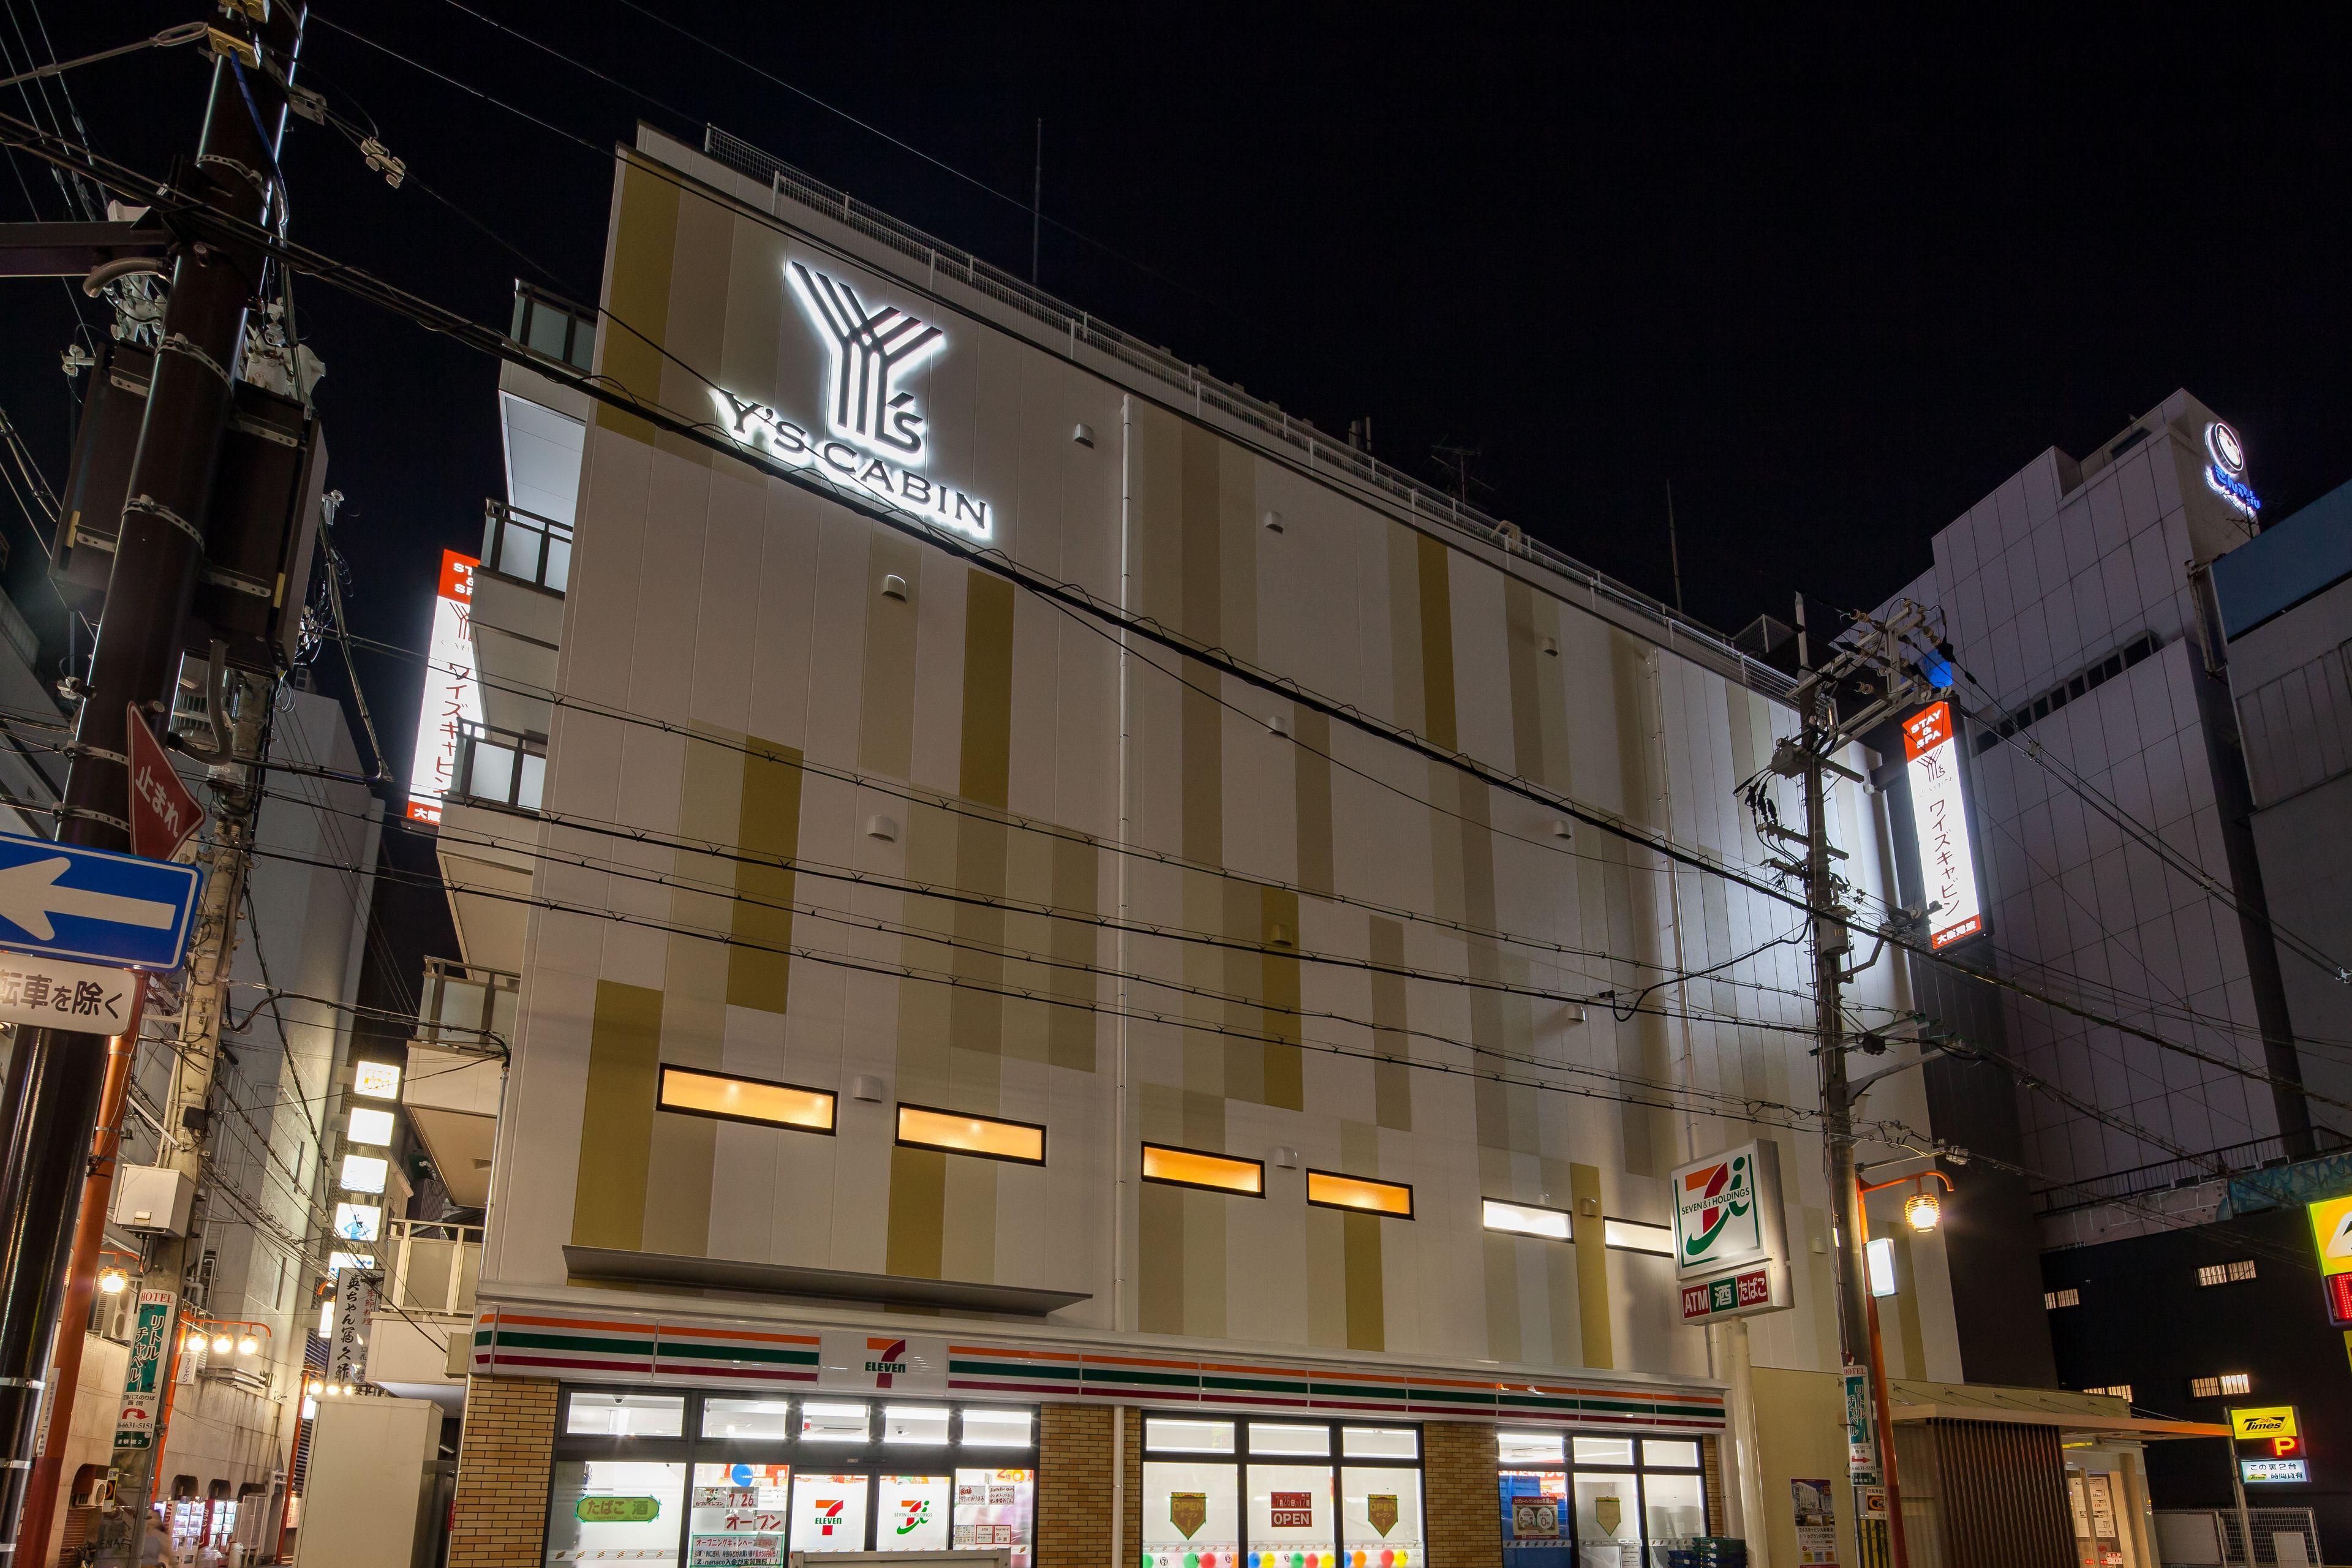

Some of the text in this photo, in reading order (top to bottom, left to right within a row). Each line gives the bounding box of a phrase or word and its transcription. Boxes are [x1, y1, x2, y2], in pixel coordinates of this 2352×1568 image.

[824, 442, 986, 530] CABIN
[1910, 709, 1942, 734] STAY
[1923, 726, 1931, 736] &
[1917, 729, 1942, 749] SPA
[135, 765, 178, 839] 止まれ
[1929, 799, 1959, 917] ワイズキャビン
[1712, 1186, 1750, 1205] HOLDINGS
[140, 1292, 173, 1304] HOTEL
[1684, 1276, 1768, 1314] ATM 酒 たばこ
[145, 1315, 165, 1360] リトル
[128, 1327, 149, 1383] チャペル
[1844, 1367, 1866, 1376] HOTEL
[1854, 1384, 1866, 1419] リトル
[1848, 1393, 1859, 1437] チャペル
[2245, 1420, 2282, 1431] Times
[2274, 1437, 2295, 1456] P
[587, 1499, 625, 1515] たばこ
[728, 1493, 754, 1507] 7/26
[726, 1514, 781, 1530] オープン
[1273, 1513, 1310, 1525] OPEN
